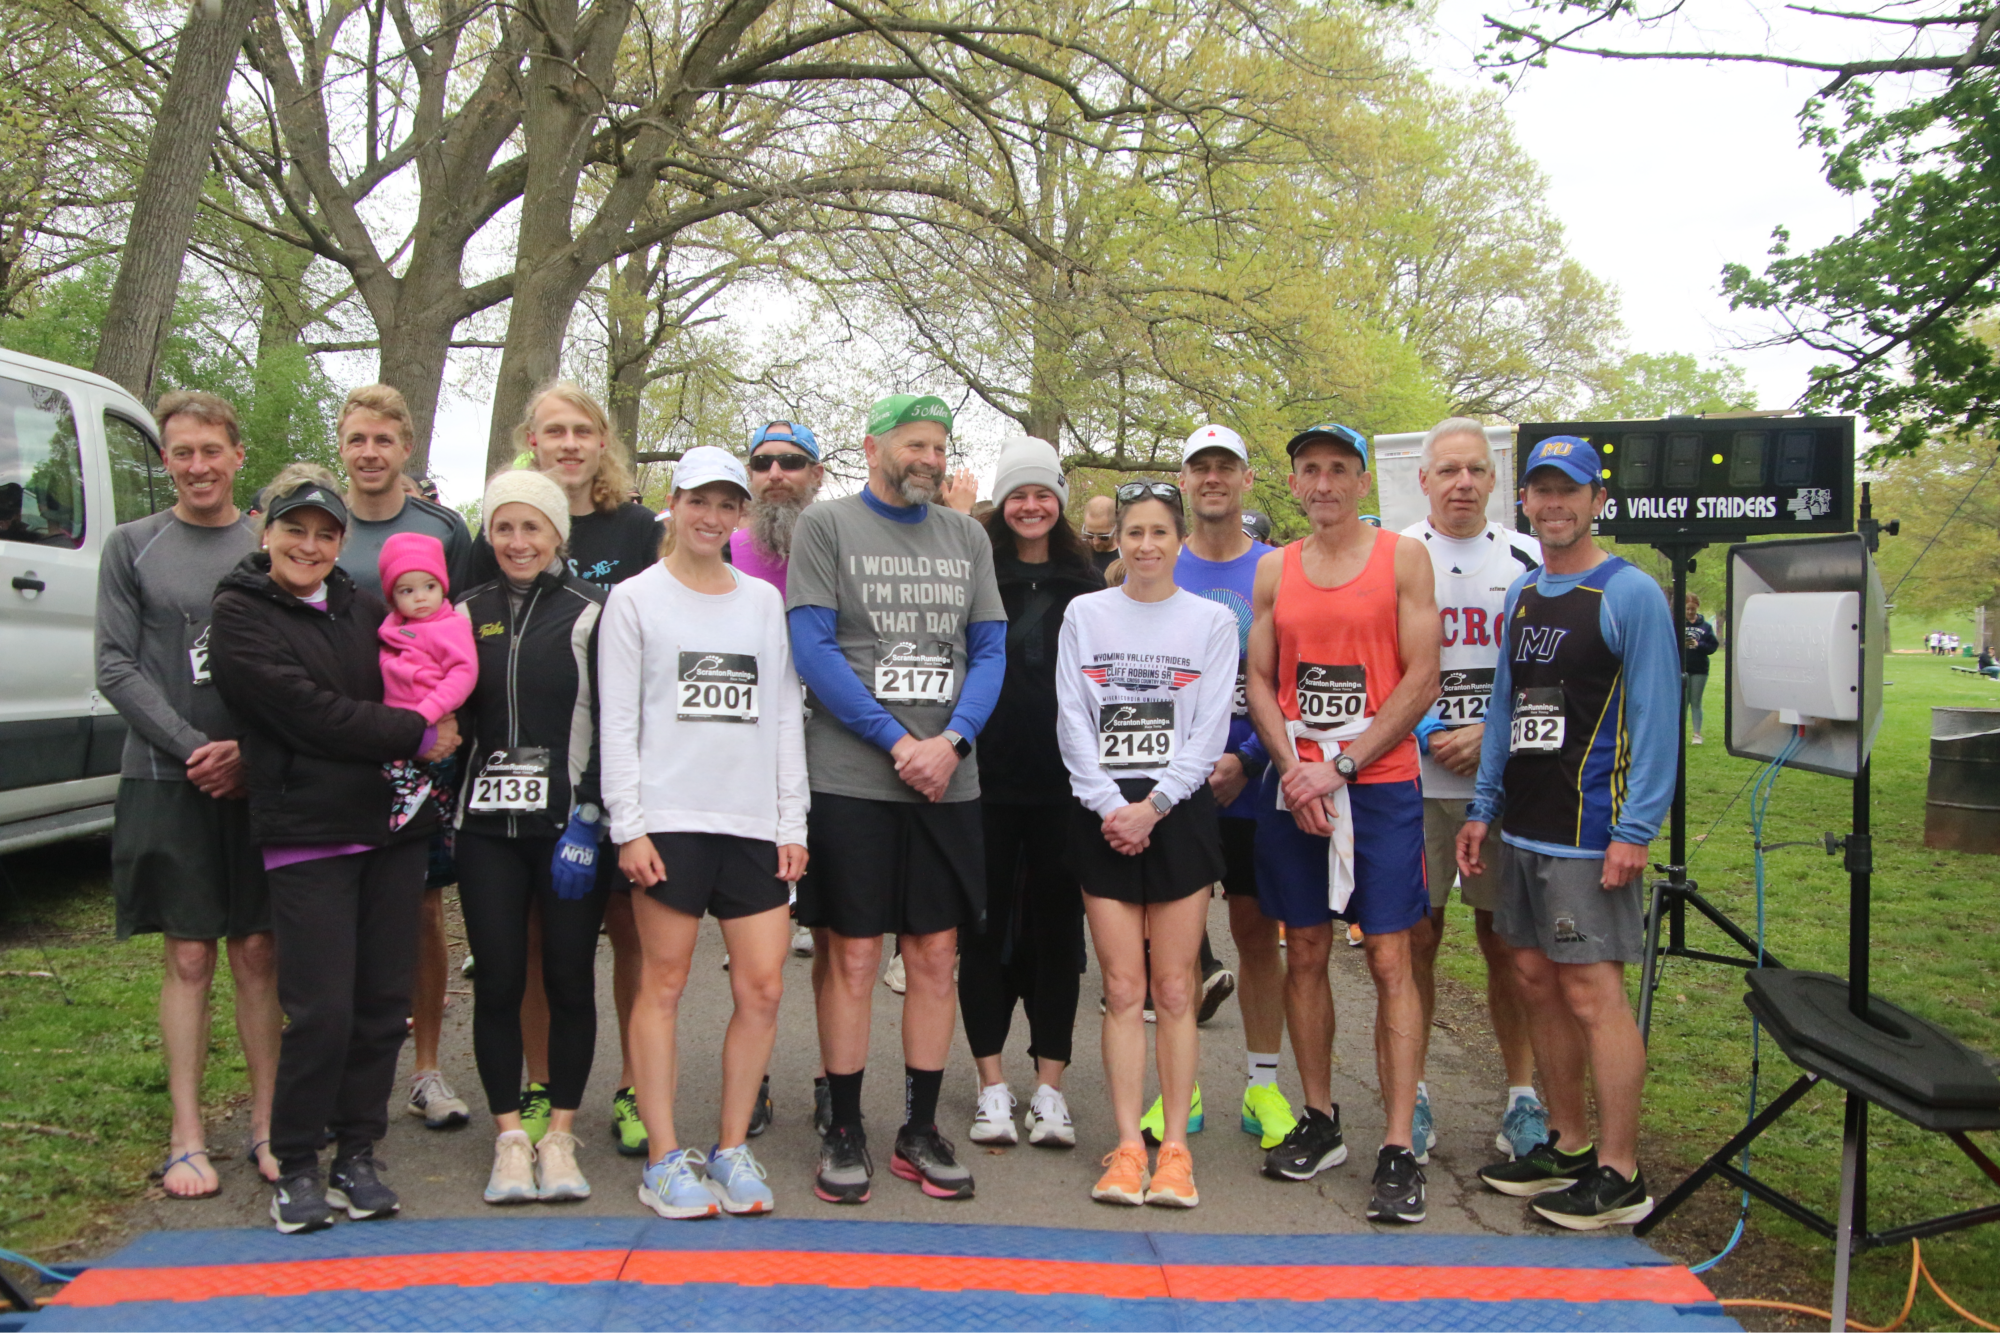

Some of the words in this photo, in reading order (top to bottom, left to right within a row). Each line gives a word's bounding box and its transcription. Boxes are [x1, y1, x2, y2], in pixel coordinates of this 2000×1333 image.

[911, 404, 921, 416] 5
[1539, 442, 1573, 458] MU
[1627, 497, 1688, 519] VALLEY
[1696, 496, 1776, 519] STRIDERS
[850, 555, 856, 575] I
[862, 555, 932, 576] WOULD
[936, 558, 971, 580] BUT
[899, 583, 965, 607] RIDING
[869, 610, 919, 633] THAT
[926, 611, 960, 635] DAY
[892, 654, 921, 662] Scranton
[921, 655, 946, 664] Running
[1093, 652, 1125, 663] WYOMING
[1127, 653, 1155, 664] VALLEY
[1155, 655, 1191, 667] STRIDERS
[696, 668, 727, 677] Scranton
[726, 669, 751, 680] Running
[881, 669, 949, 694] 2177
[1106, 668, 1126, 678] CLIFF
[1128, 669, 1160, 680] ROBBINS
[1161, 670, 1172, 680] SR
[1305, 679, 1330, 687] Scranton
[1329, 680, 1357, 689] Running
[1444, 684, 1471, 692] Scranton
[1471, 682, 1494, 690] Running
[682, 683, 752, 710] 2001
[1298, 692, 1362, 717] 2050
[1528, 703, 1554, 712] Running
[1113, 719, 1141, 727] Scranton
[1140, 718, 1166, 726] Running
[1104, 732, 1170, 757] 2149
[509, 763, 538, 773] Running
[477, 779, 541, 803] 2138
[560, 845, 594, 866] RUN
